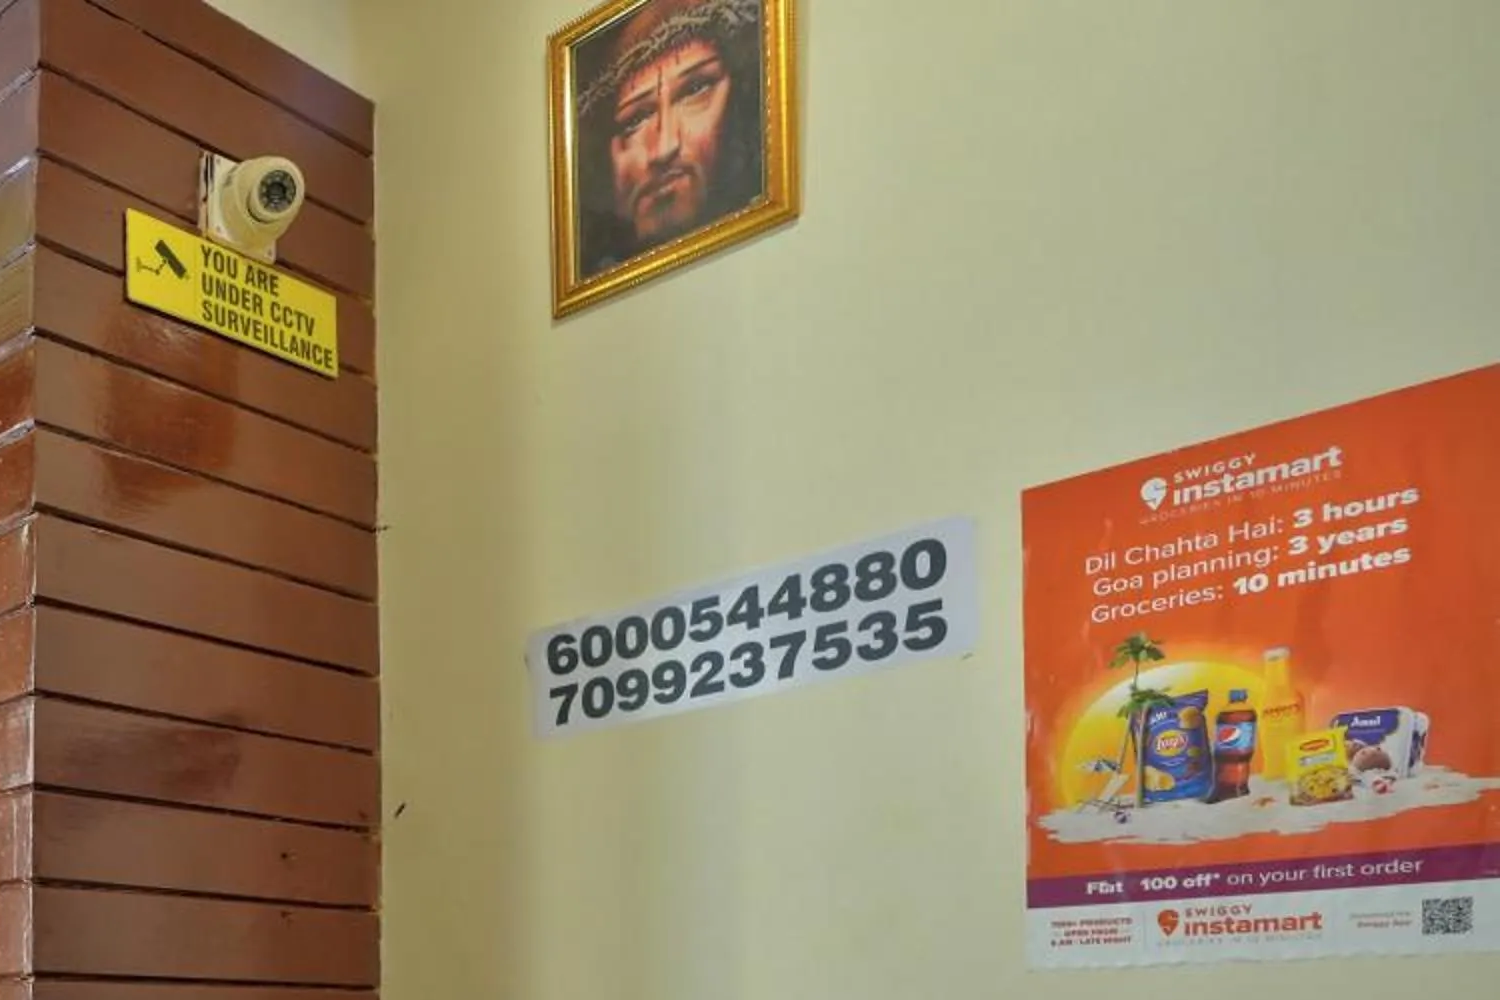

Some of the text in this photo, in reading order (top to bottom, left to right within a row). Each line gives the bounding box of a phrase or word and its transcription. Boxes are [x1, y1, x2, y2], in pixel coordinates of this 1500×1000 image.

[201, 244, 280, 297] YOU ARE
[201, 272, 315, 337] UNDER CCTV
[201, 300, 333, 369] SURVEILLANCE
[1173, 452, 1257, 484] SWIGGY
[1173, 445, 1343, 507] instamart
[1084, 486, 1421, 576] Dil Chahta Hai: 3 hours
[1093, 517, 1409, 597] Goa planning: 3 years
[546, 538, 947, 675] 6000544880
[1091, 546, 1412, 623] Groceries: 10 minutes
[548, 598, 948, 727] 7099237535
[1140, 876, 1178, 892] 100
[1227, 871, 1253, 886] on
[1259, 868, 1307, 886] your
[1313, 863, 1354, 878] first
[1360, 858, 1424, 876] order
[1183, 910, 1323, 937] instamart
[1184, 903, 1253, 918] SWIGGY
